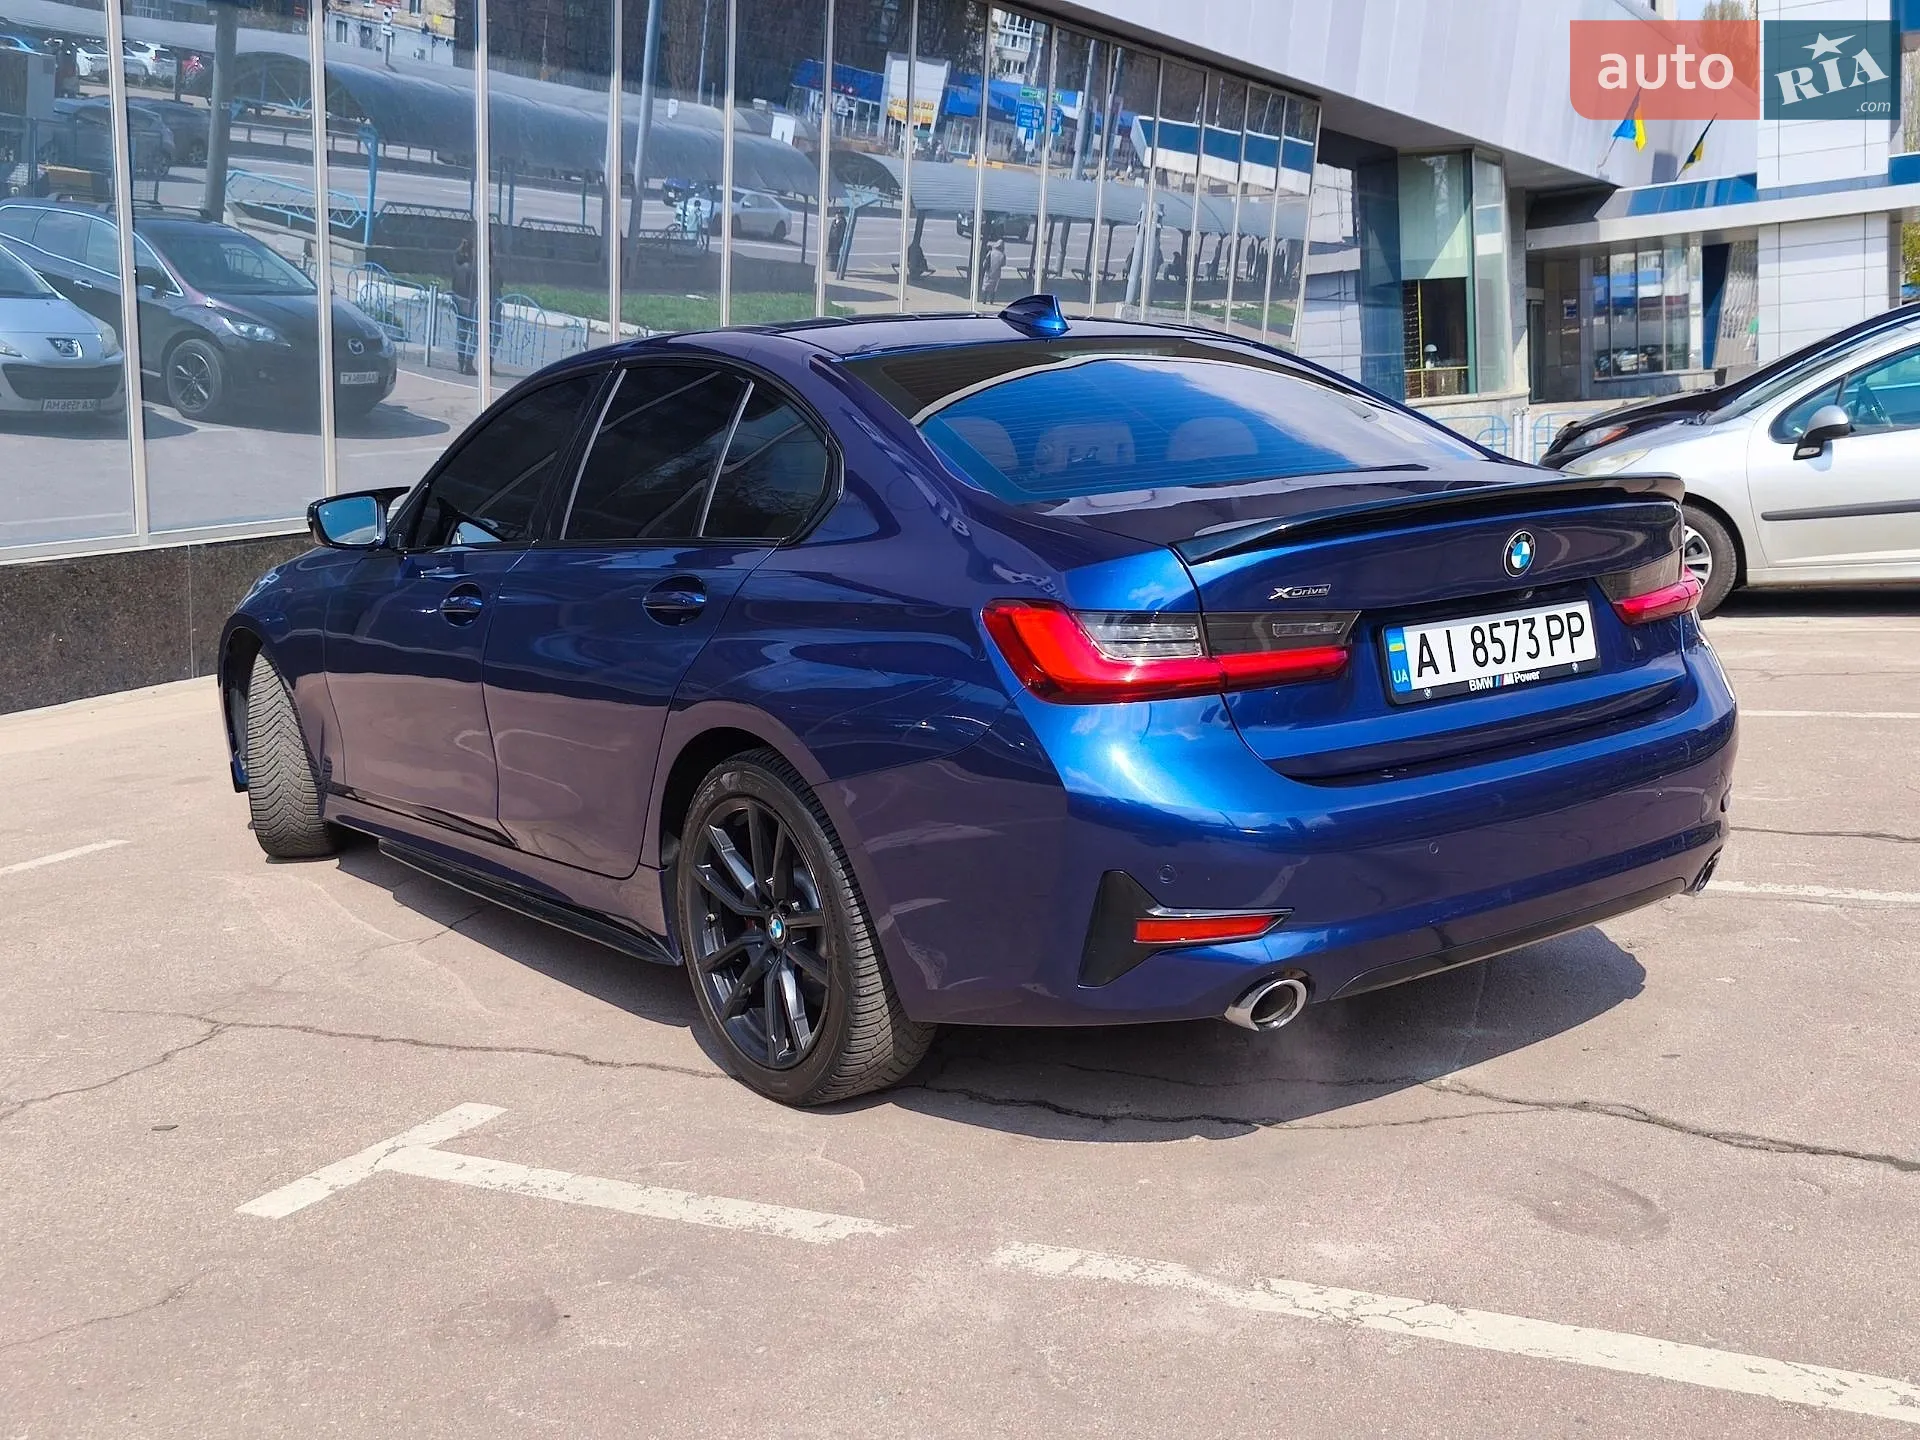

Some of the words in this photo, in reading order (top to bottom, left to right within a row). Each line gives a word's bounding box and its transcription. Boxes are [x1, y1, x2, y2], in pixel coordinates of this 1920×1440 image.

[1417, 629, 1456, 678] AI
[1470, 616, 1540, 668] 8573
[1545, 611, 1585, 657] PP
[1393, 669, 1409, 684] UA
[1468, 676, 1493, 692] BMW
